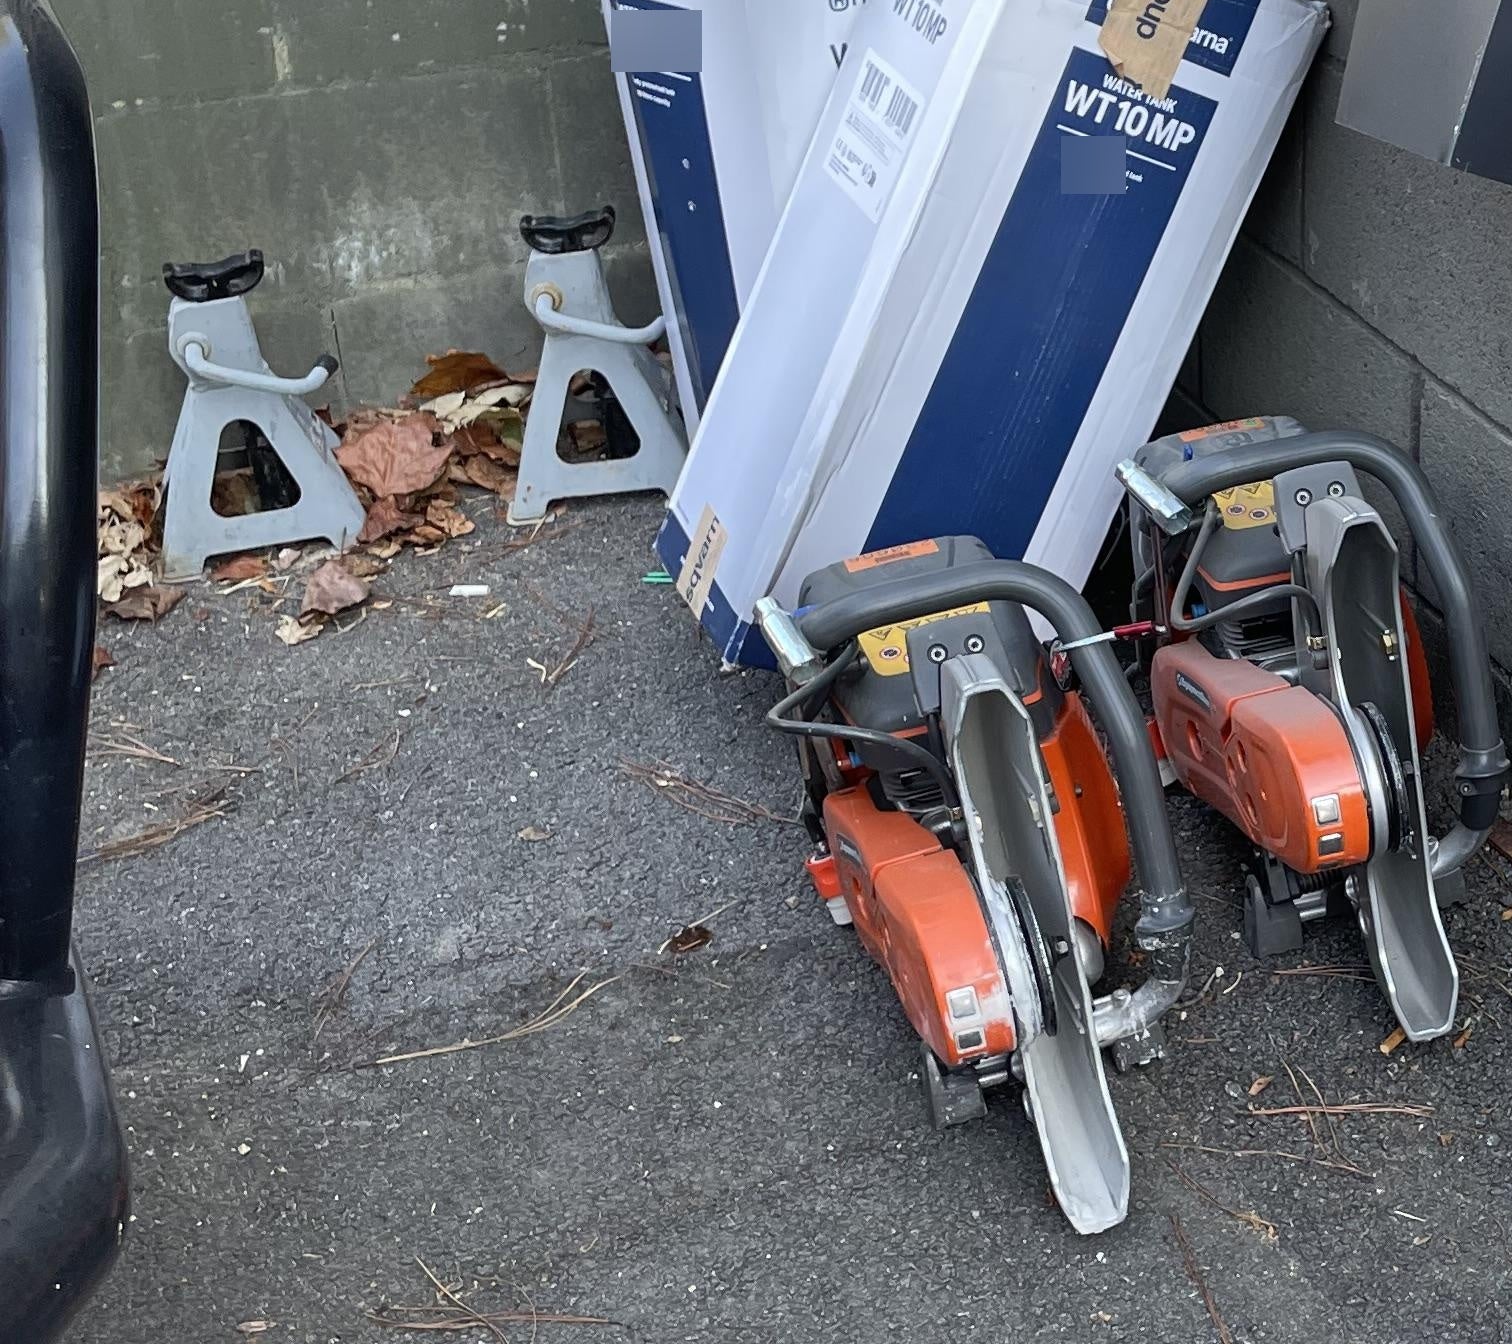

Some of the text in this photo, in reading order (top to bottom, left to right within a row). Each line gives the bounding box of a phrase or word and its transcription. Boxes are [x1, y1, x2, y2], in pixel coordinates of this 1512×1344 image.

[924, 8, 948, 45] MP
[1064, 79, 1196, 152] WT 10 MP
